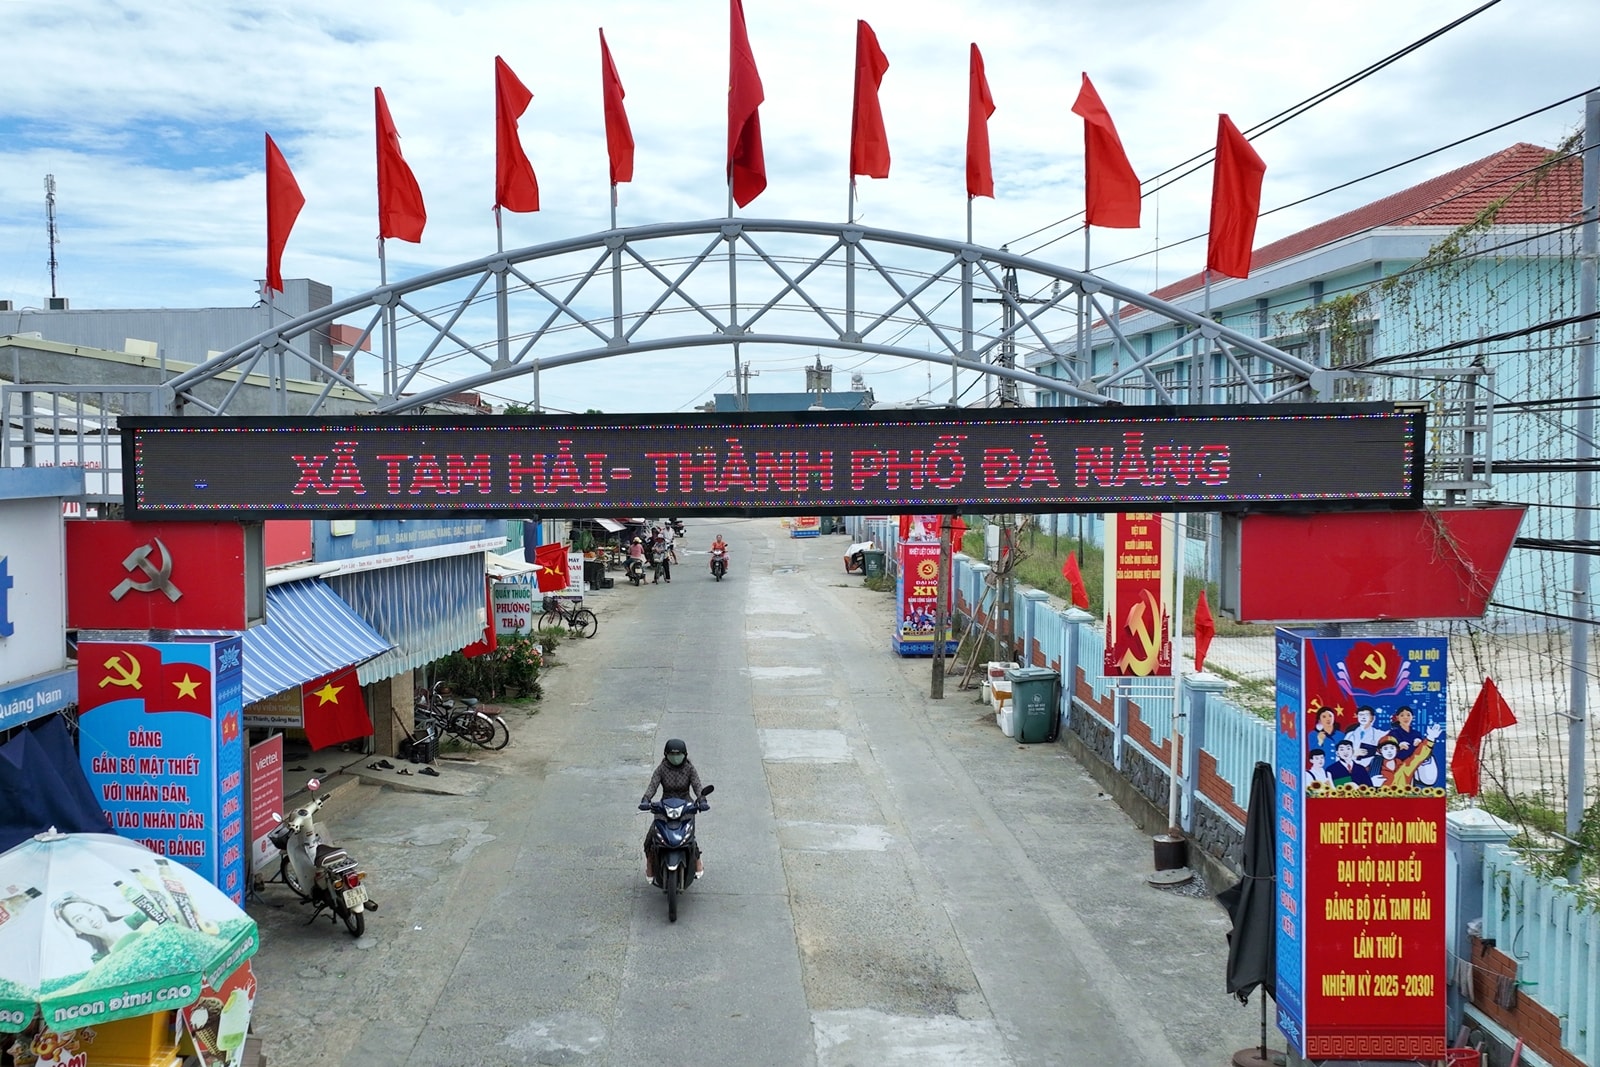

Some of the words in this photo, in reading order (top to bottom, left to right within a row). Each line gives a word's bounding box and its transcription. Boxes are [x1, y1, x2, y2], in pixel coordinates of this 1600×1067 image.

[291, 440, 366, 494] XÃ
[376, 454, 491, 494] TAM
[645, 437, 833, 492] THÀNH
[851, 435, 967, 490] PHỐ
[981, 434, 1060, 488] ĐÀ
[1409, 650, 1423, 662] ĐẠI
[1425, 648, 1439, 662] HỘI
[36, 688, 62, 707] Nam
[129, 726, 162, 747] ĐẢNG
[92, 752, 116, 774] GẮN
[121, 755, 136, 774] BÓ
[140, 756, 165, 778] MẬT
[168, 754, 200, 775] THIẾT
[103, 782, 121, 801] VỚI
[126, 783, 158, 801] NHÂN
[162, 783, 190, 804] DÂN,
[117, 809, 139, 827] VÀO
[143, 810, 176, 829] NHÂN
[180, 811, 204, 829] DÂN
[1320, 817, 1350, 849] NHIỆT
[1352, 817, 1373, 849] LIỆT
[1375, 817, 1403, 844] CHÀO
[1406, 817, 1437, 844] MỪNG
[169, 835, 205, 856] ĐẢNG!
[1338, 860, 1355, 887] ĐẠI
[1358, 856, 1375, 887] HỘI
[1378, 860, 1395, 887] ĐẠI
[1398, 851, 1422, 882] BIỂU
[1325, 891, 1354, 920] ĐẢNG
[1356, 894, 1370, 925] BỘ
[1373, 894, 1387, 920] XÃ
[1389, 898, 1410, 920] TAM
[1413, 891, 1431, 920] HẢI
[1354, 929, 1374, 958] LẦN
[1376, 931, 1397, 958] THỨ
[1398, 937, 1403, 958] I
[156, 985, 191, 1001] CAO
[1322, 970, 1355, 1001] NHIỆM
[1358, 970, 1371, 996] KỲ
[1374, 975, 1399, 996] 2025
